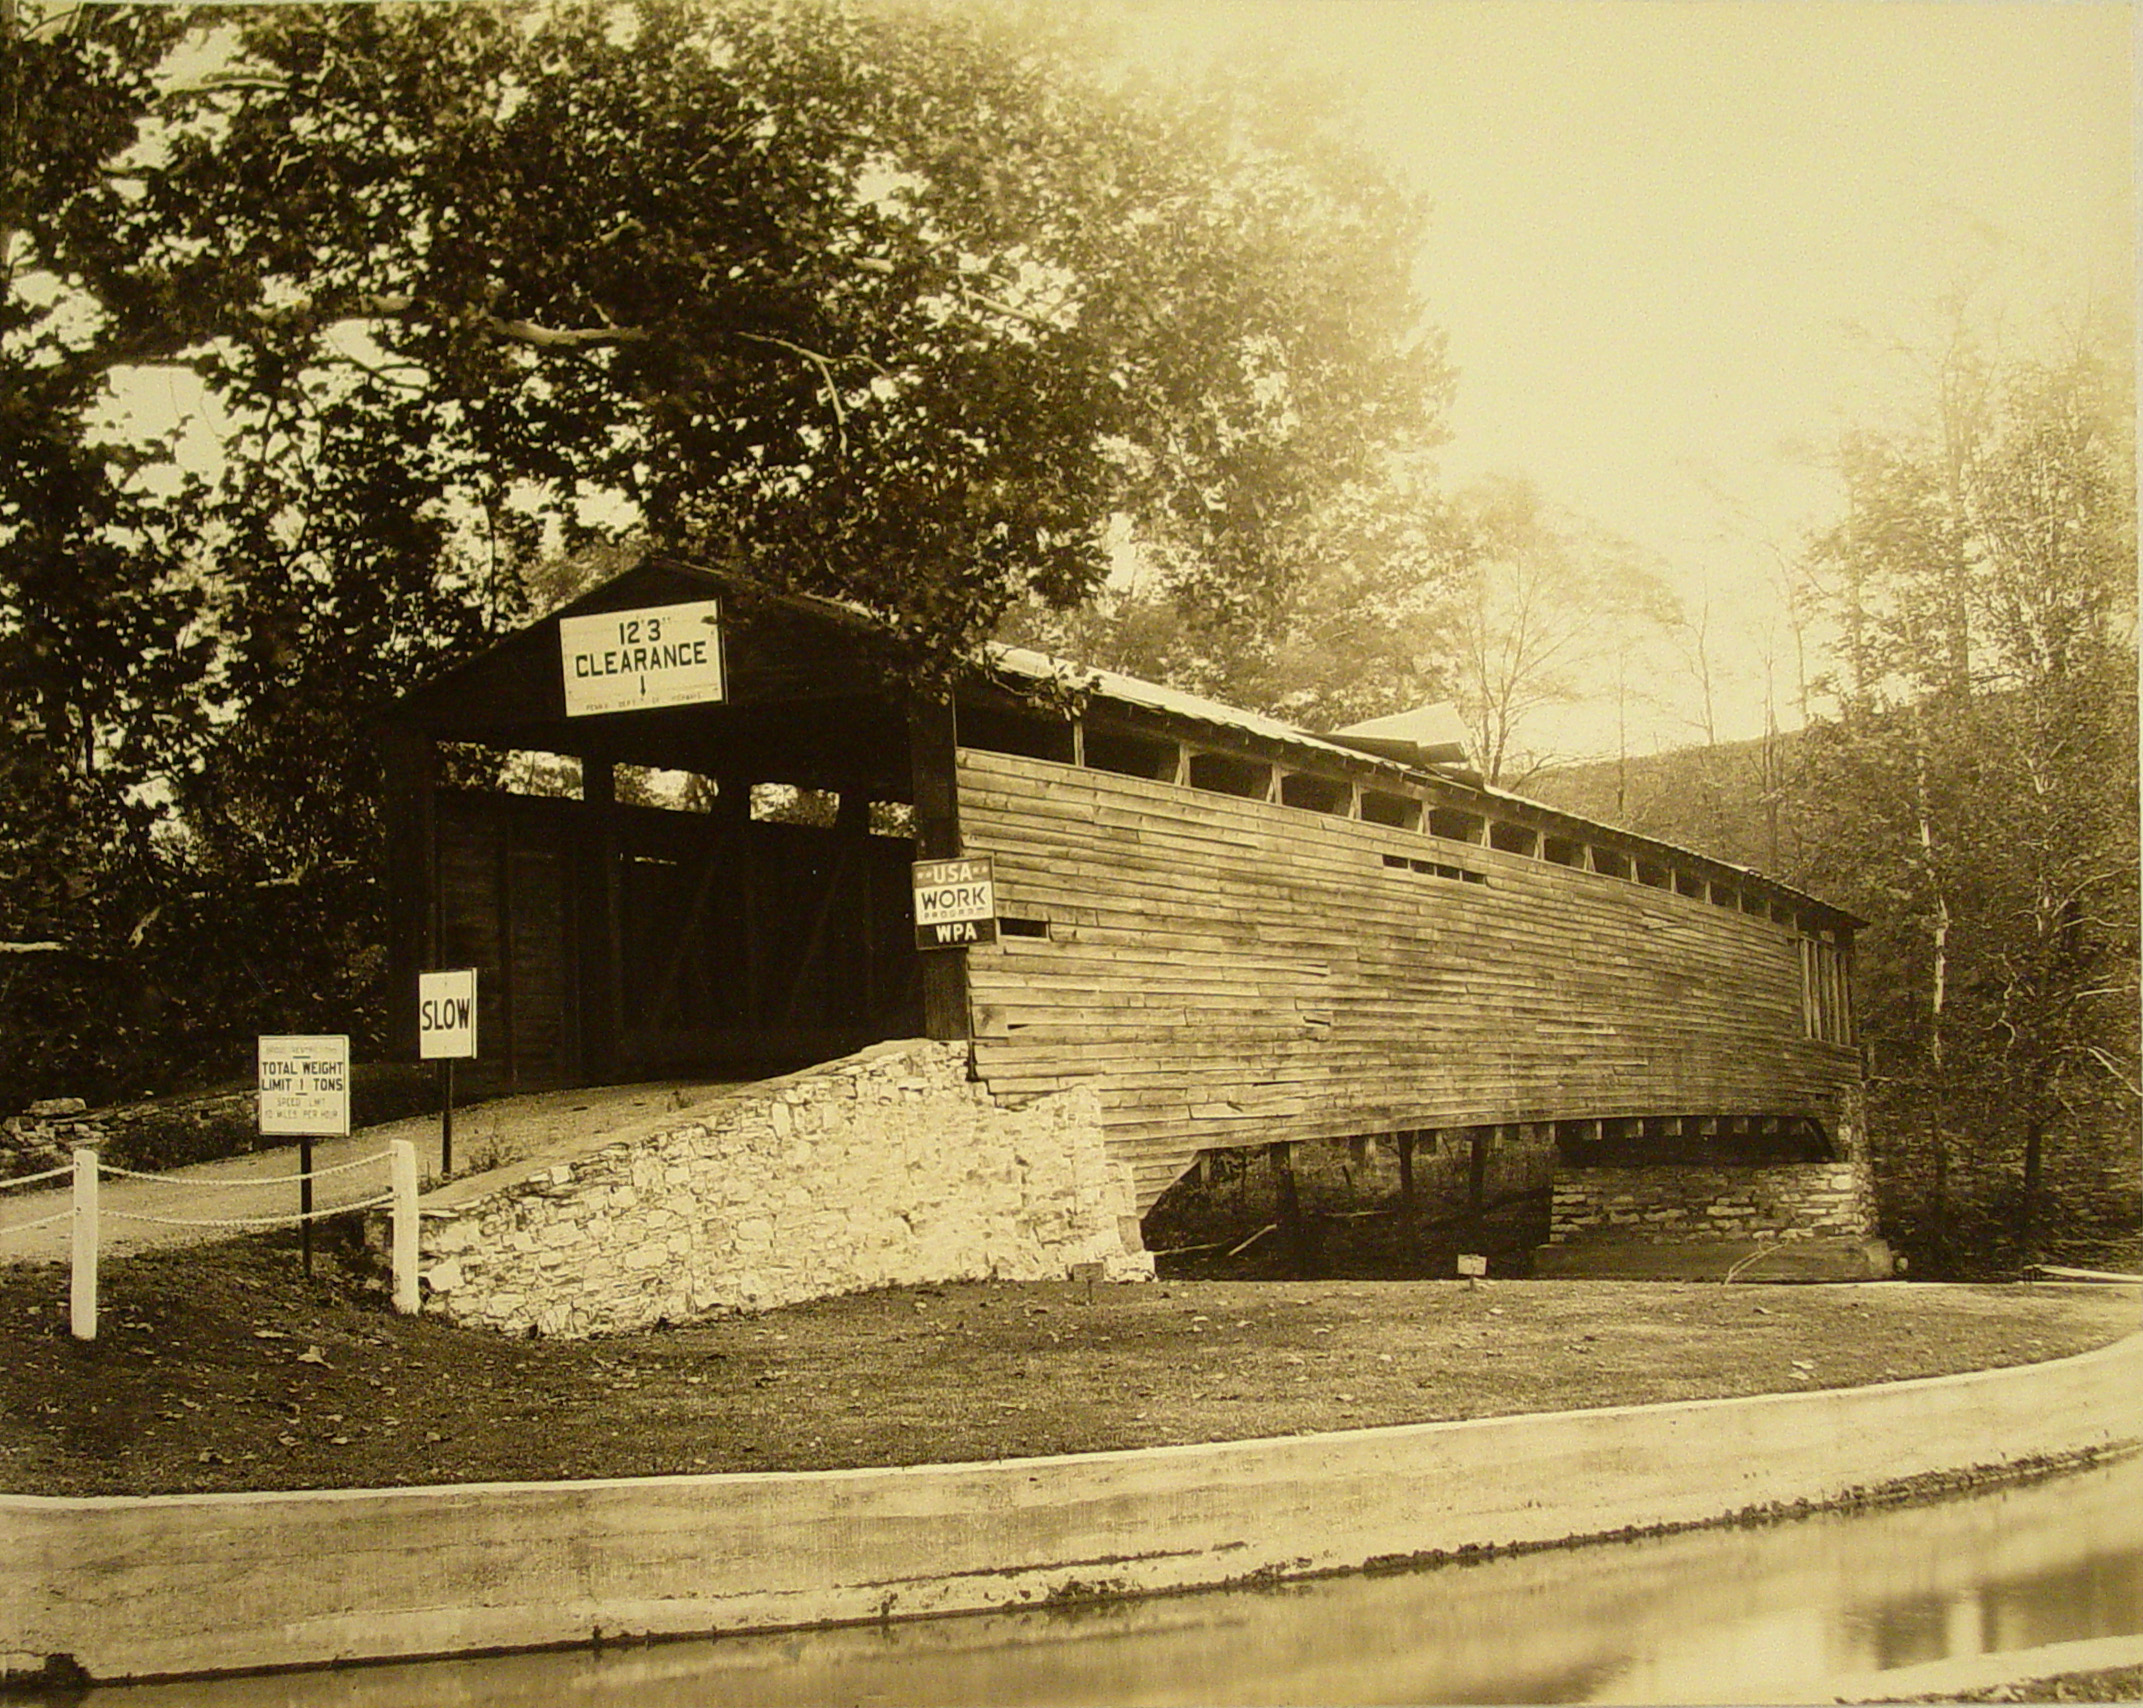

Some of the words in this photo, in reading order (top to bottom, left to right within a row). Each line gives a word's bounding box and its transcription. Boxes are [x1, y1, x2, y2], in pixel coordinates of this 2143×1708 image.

[575, 640, 708, 678] CLEARANCE
[933, 862, 974, 884] USA
[921, 886, 987, 911] WORK
[935, 921, 978, 944] WPA
[421, 998, 471, 1032] SLOW
[261, 1061, 299, 1075] TOTAL
[302, 1061, 344, 1075] WEIGHT
[261, 1078, 293, 1092] LIMIT
[299, 1078, 304, 1091] 1
[313, 1078, 344, 1092] TONS
[276, 1097, 301, 1108] SPEED
